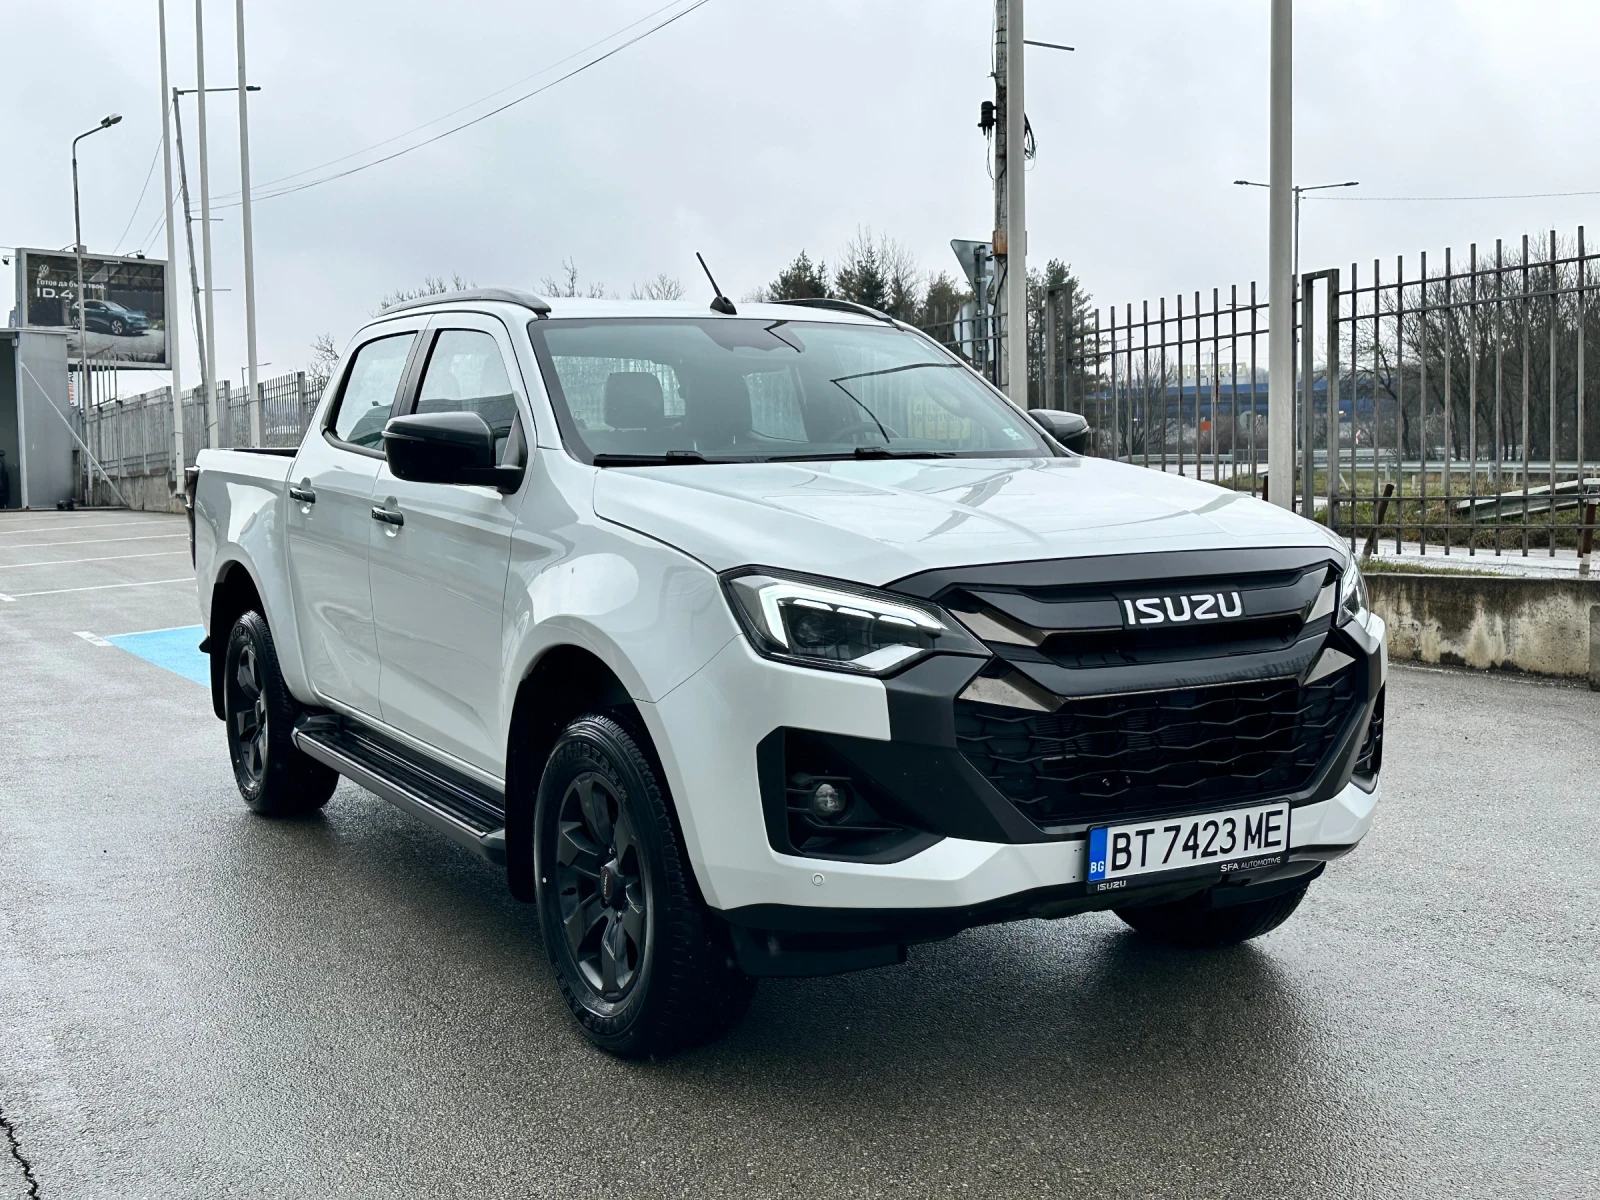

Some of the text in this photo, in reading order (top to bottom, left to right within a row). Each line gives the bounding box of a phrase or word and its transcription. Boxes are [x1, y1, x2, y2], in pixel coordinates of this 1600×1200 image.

[36, 277, 57, 287] Готов
[36, 287, 74, 300] ID.4
[1123, 591, 1242, 625] ISUZU
[1111, 809, 1284, 872] BT 7423 ME
[1090, 860, 1105, 874] BG
[1220, 856, 1281, 872] SFA AUTOMOTIVE
[1097, 880, 1127, 891] ISUZU
